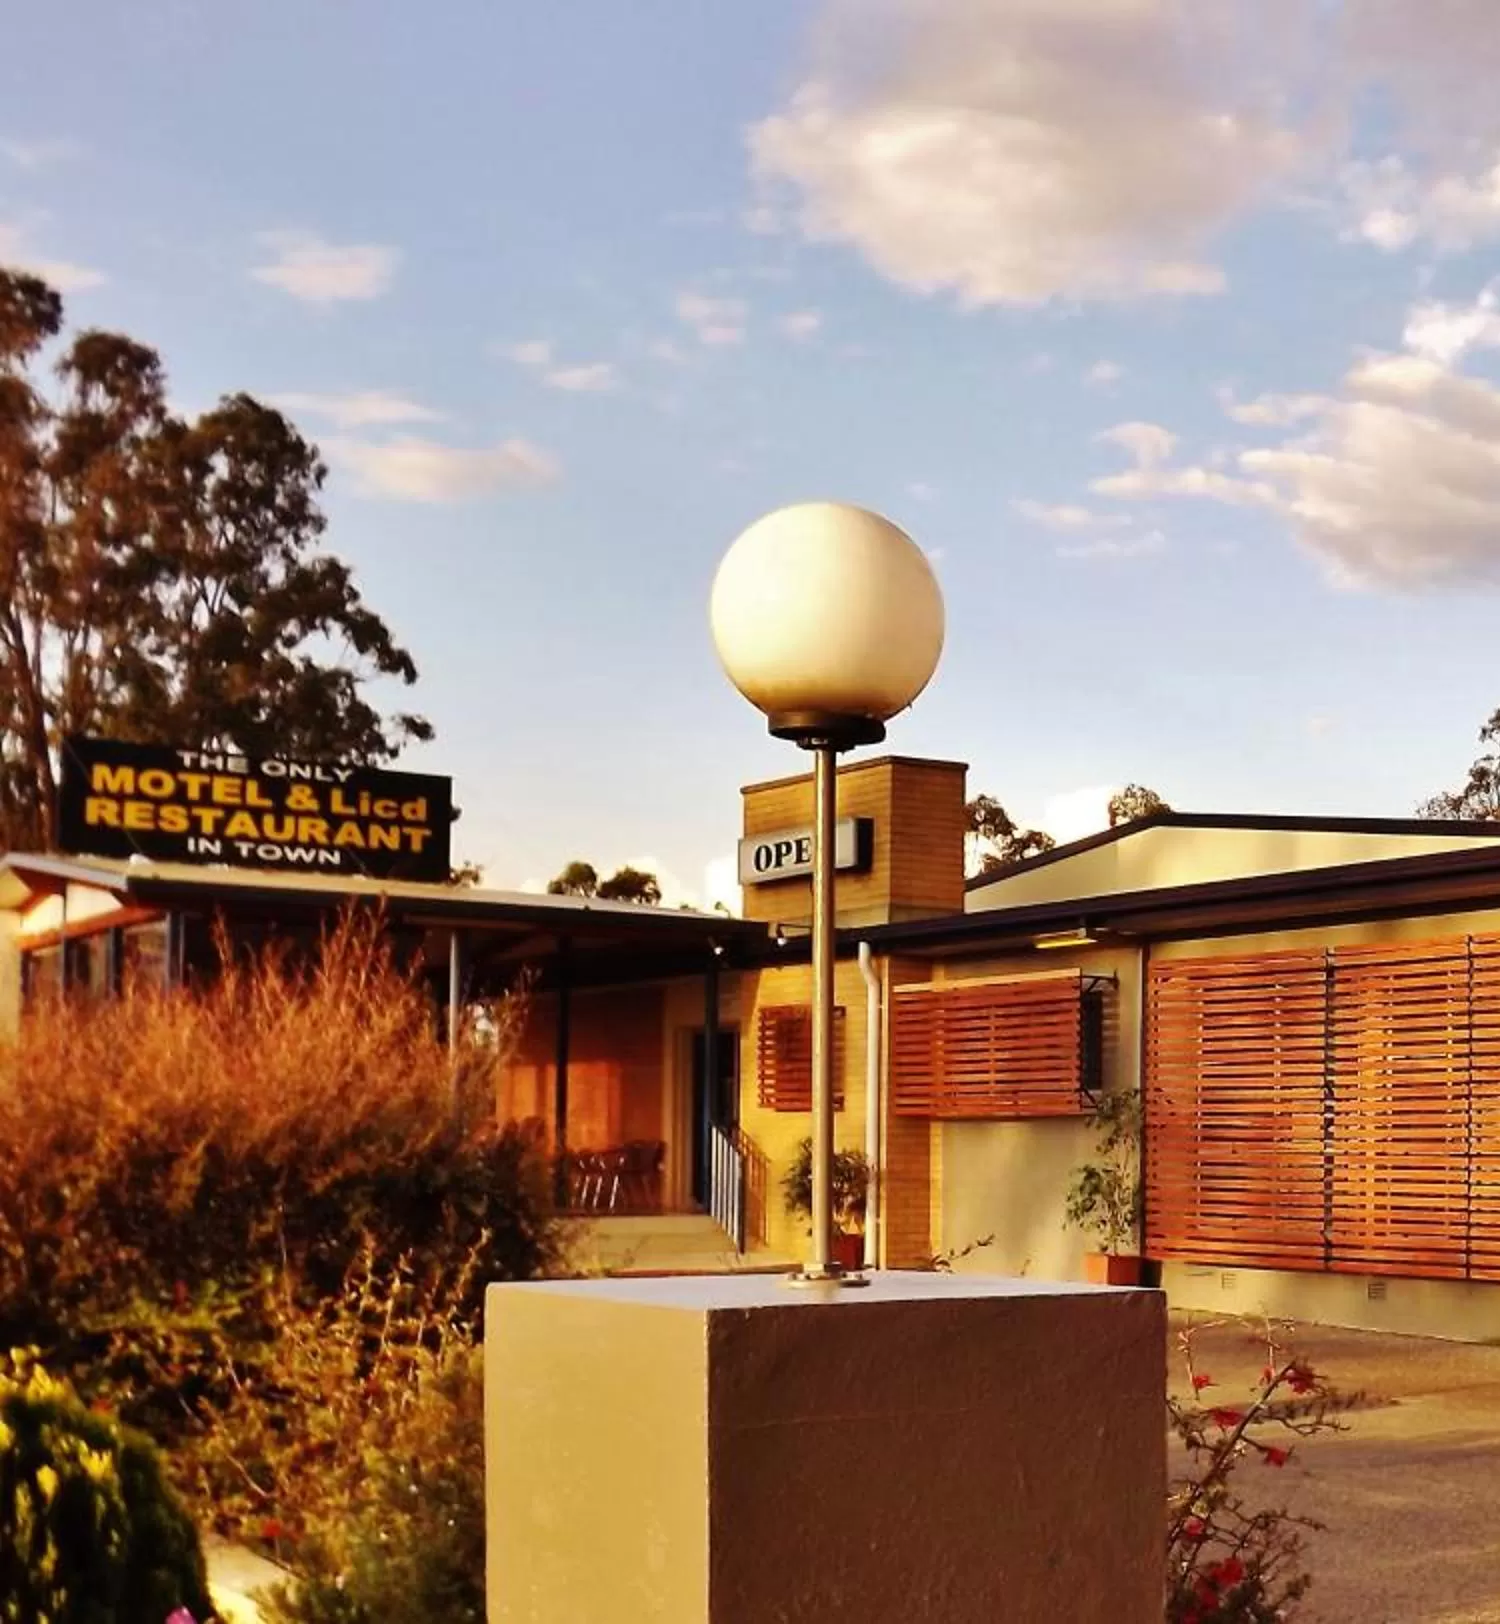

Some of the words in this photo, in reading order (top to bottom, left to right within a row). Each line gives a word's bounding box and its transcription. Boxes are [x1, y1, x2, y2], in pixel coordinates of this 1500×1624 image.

[178, 751, 249, 773] THE
[262, 760, 354, 782] ONLY
[91, 763, 274, 807] MOTEL
[285, 785, 319, 813] &
[331, 790, 427, 821] Licd
[86, 798, 431, 852] RESTAURANT
[187, 836, 222, 856] IN
[234, 842, 342, 866] TOWN
[754, 838, 813, 872] OPE
